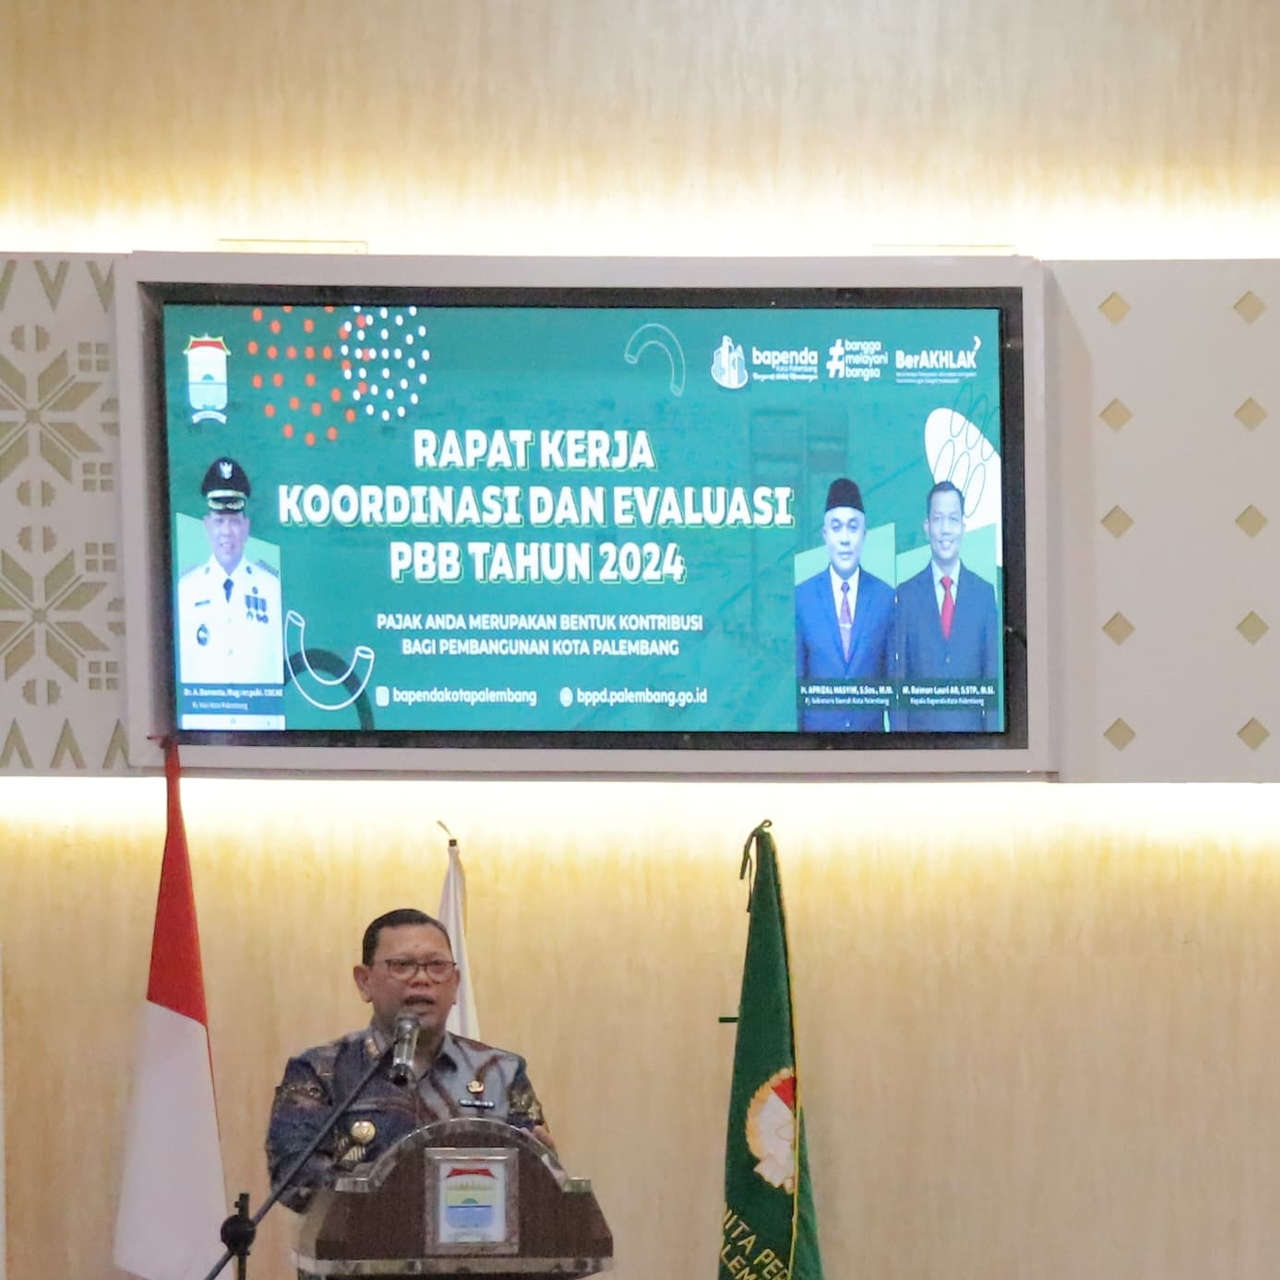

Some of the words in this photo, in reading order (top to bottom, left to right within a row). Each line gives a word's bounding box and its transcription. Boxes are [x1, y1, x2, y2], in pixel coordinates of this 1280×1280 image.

[845, 339, 881, 353] bangga
[752, 347, 818, 367] bapenda
[845, 353, 888, 367] melayani
[895, 350, 977, 369] BerAKHLAK
[845, 367, 881, 381] bangsa
[413, 429, 534, 470] RAPAT
[540, 429, 657, 470] KERJA
[278, 484, 523, 525] KOORDINASI
[528, 485, 607, 526] DAN
[613, 485, 796, 527] EVALUASI
[389, 541, 463, 582] PBB
[468, 541, 595, 583] TAHUN
[599, 542, 687, 583] 2024
[376, 614, 423, 630] PAJAK
[424, 614, 466, 630] ANDA
[469, 614, 556, 630] MERUPAKAN
[559, 614, 616, 630] BENTUK
[619, 614, 703, 631] KONTRIBUSI
[402, 639, 436, 655] BAGI
[439, 639, 549, 655] PEMBANGUNAN
[552, 639, 590, 655] KOTA
[592, 639, 679, 656] PALEMBANG
[393, 687, 537, 707] bapendakotapalembang
[577, 686, 708, 707] bppd.palembang.go.id
